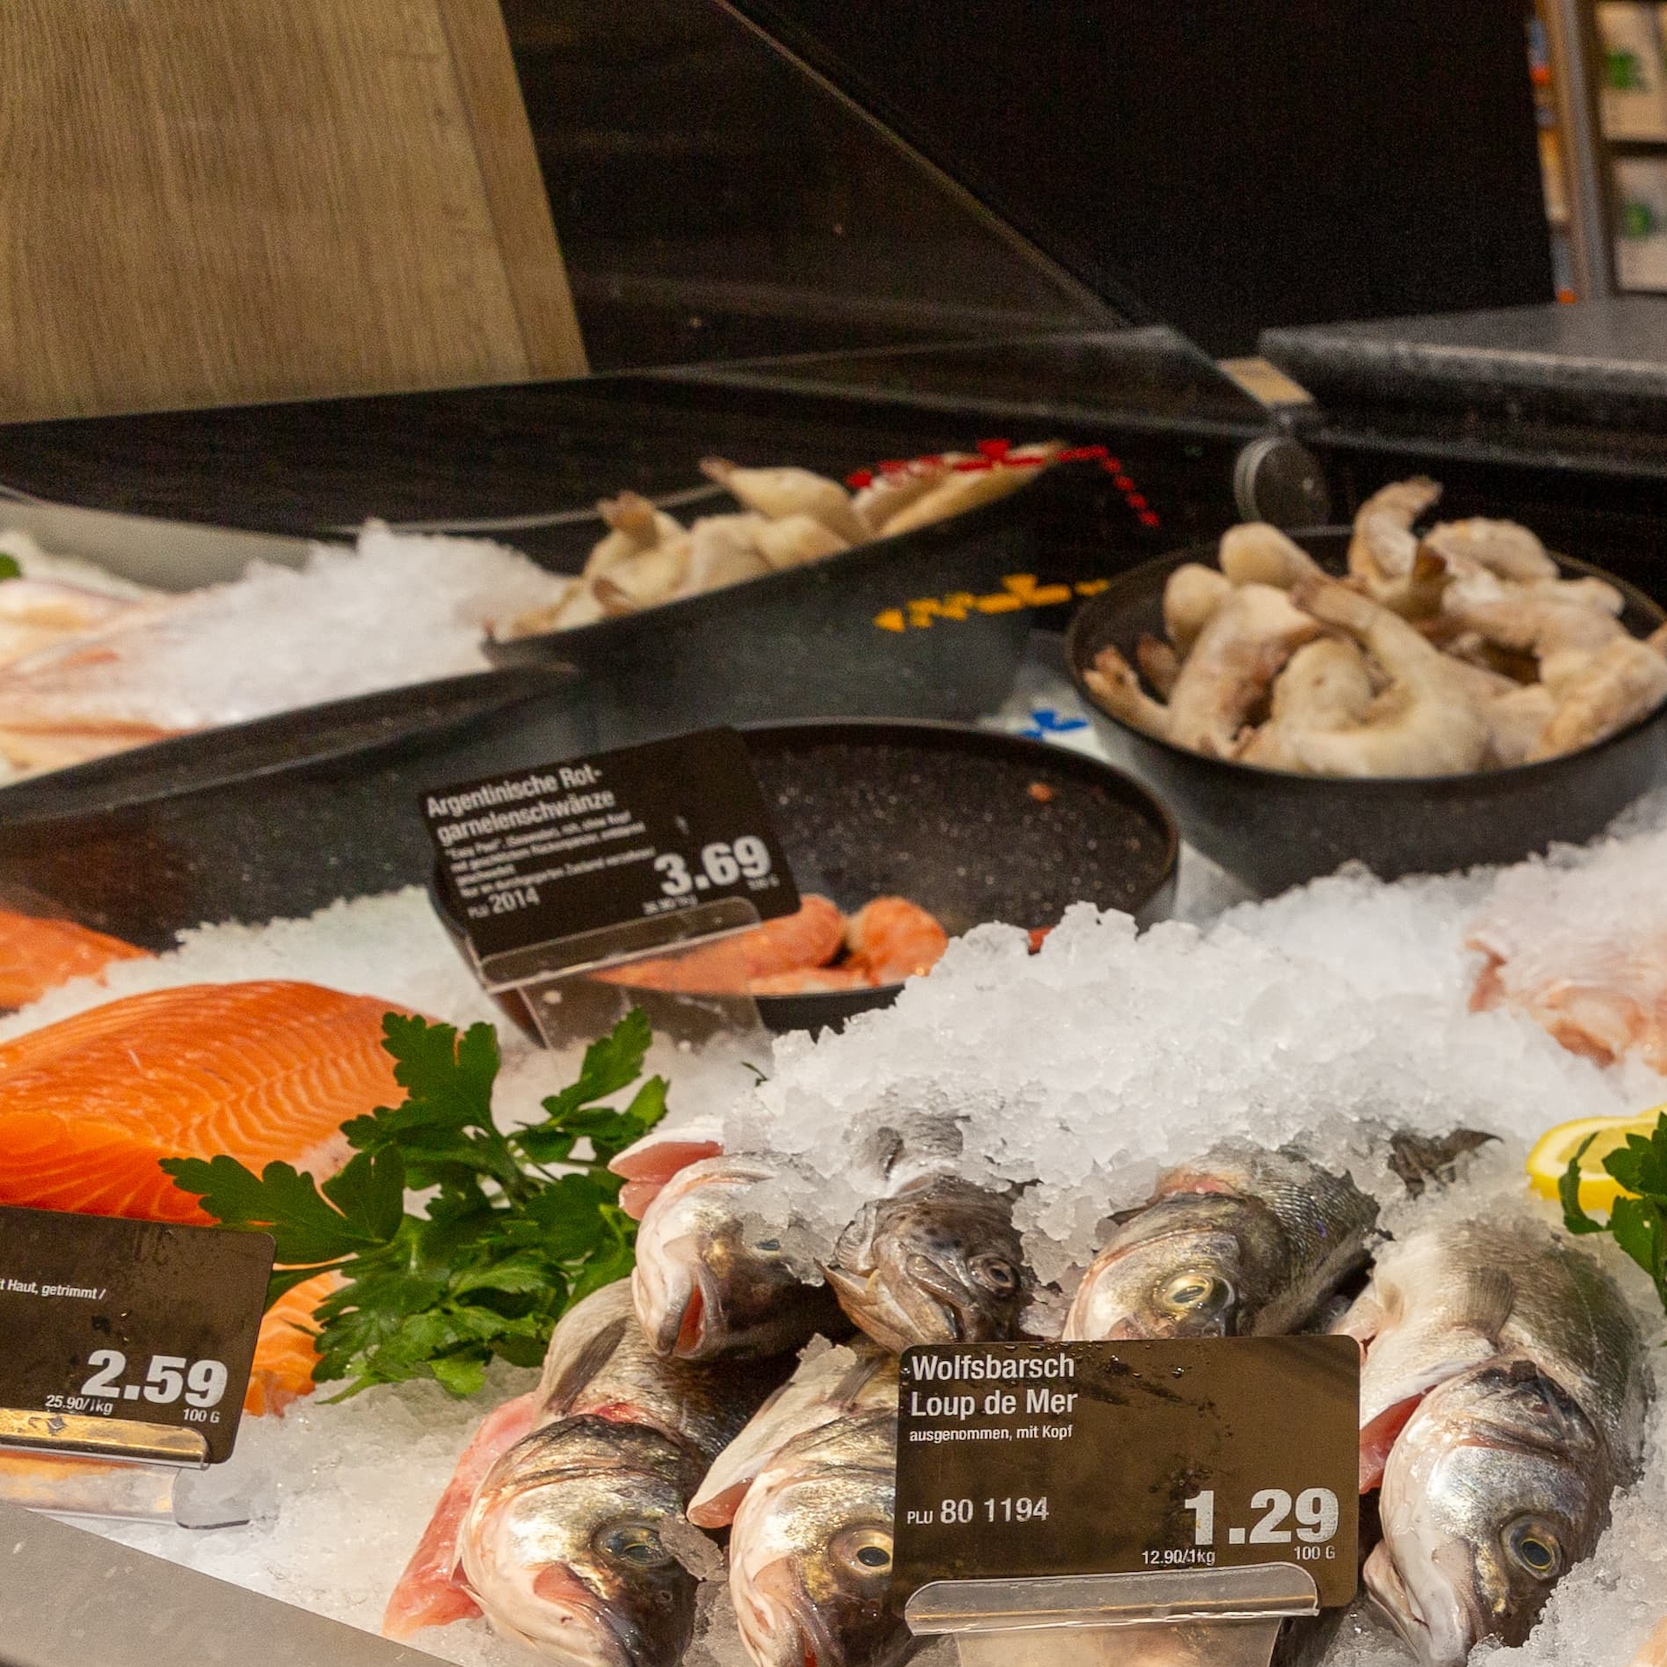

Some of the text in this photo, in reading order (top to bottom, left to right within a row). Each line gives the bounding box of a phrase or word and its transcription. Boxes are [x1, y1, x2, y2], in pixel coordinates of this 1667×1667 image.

[427, 763, 602, 817] Argentinische Rot-
[437, 789, 615, 847] garnelenschwänze
[653, 834, 772, 897] 3.69
[488, 886, 540, 914] 2014
[8, 1279, 38, 1294] Haut,
[41, 1284, 97, 1299] getrimmt
[81, 1349, 228, 1408] 2.59
[911, 1353, 1075, 1382] Wolfsbarsch
[45, 1395, 114, 1415] 25.90/1kg
[183, 1408, 220, 1423] 100 G
[911, 1388, 1078, 1421] Loup de Mer
[909, 1424, 1072, 1444] ausgenommen, mit Kopf
[907, 1496, 1049, 1525] PLU 80 1194
[1184, 1488, 1340, 1546] 1.29
[1141, 1548, 1216, 1567] 12.90/1kg
[1293, 1545, 1335, 1561] 100 G
